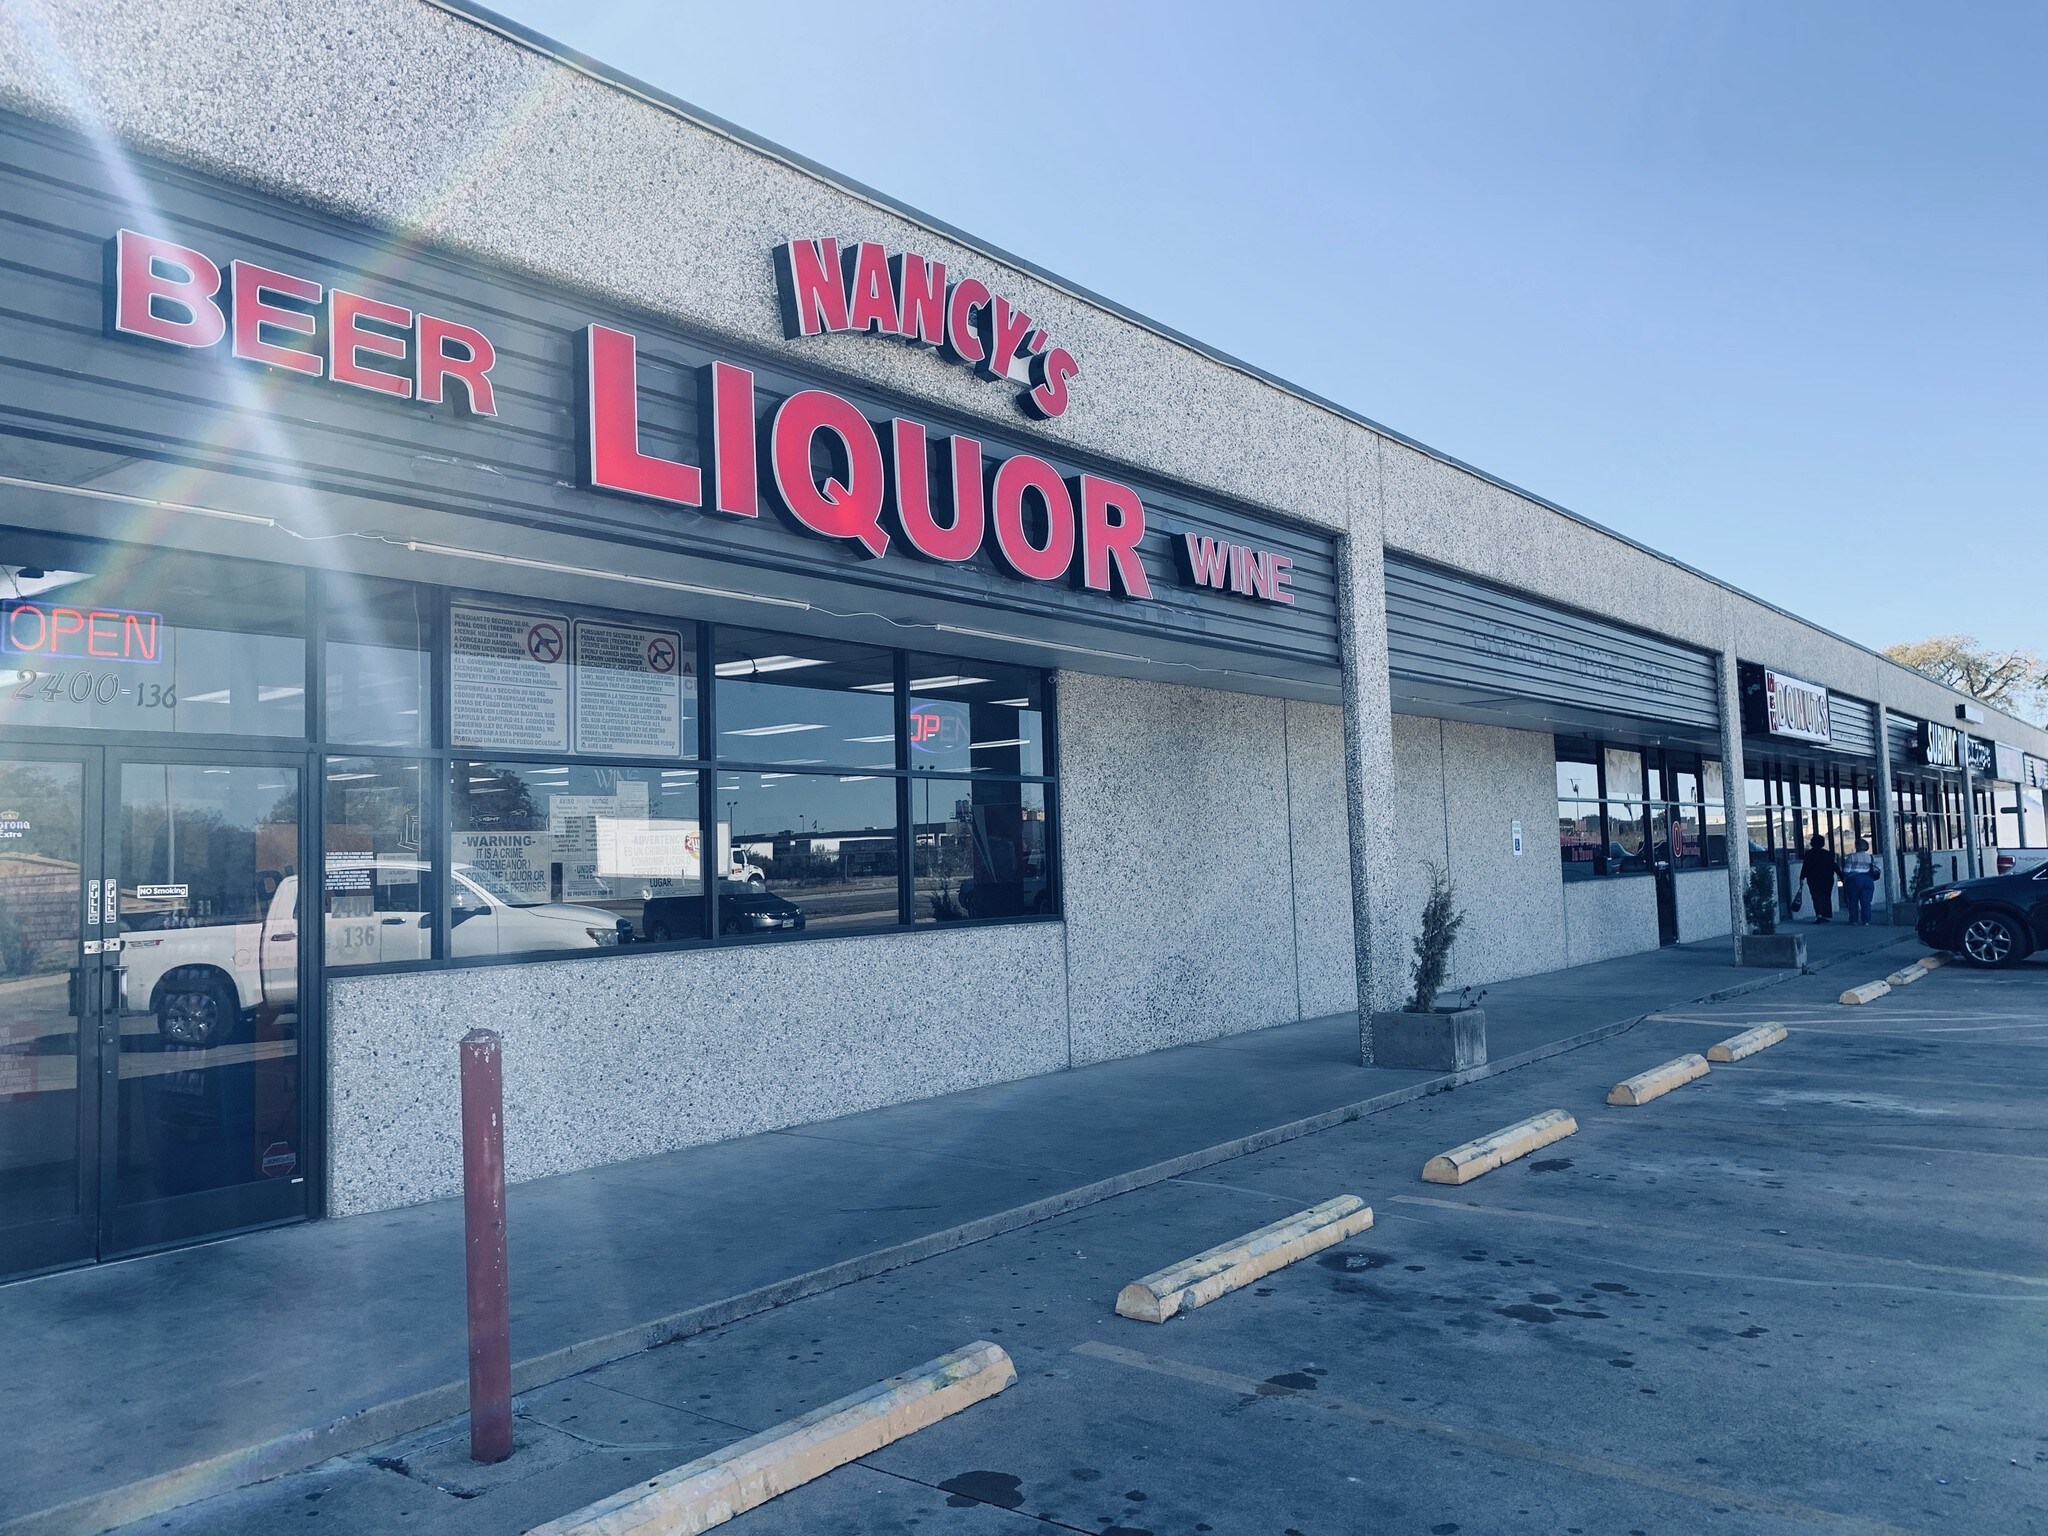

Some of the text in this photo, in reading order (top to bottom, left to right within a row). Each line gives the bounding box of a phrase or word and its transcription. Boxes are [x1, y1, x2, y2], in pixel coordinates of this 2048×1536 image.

[115, 228, 497, 417] BEER
[779, 237, 1079, 419] NANCY'S
[585, 323, 1153, 600] LIQUOR
[1180, 531, 1294, 604] WINE
[10, 605, 156, 659] OPEN
[459, 636, 491, 644] CONCEALED
[1775, 682, 1828, 736] DONUTS
[0, 821, 30, 830] orona
[485, 848, 491, 858] IS
[500, 848, 523, 858] CRIME
[153, 887, 186, 895] Smoking
[505, 871, 532, 881] LIQUOR
[534, 870, 544, 880] OR
[344, 926, 375, 948] 136
